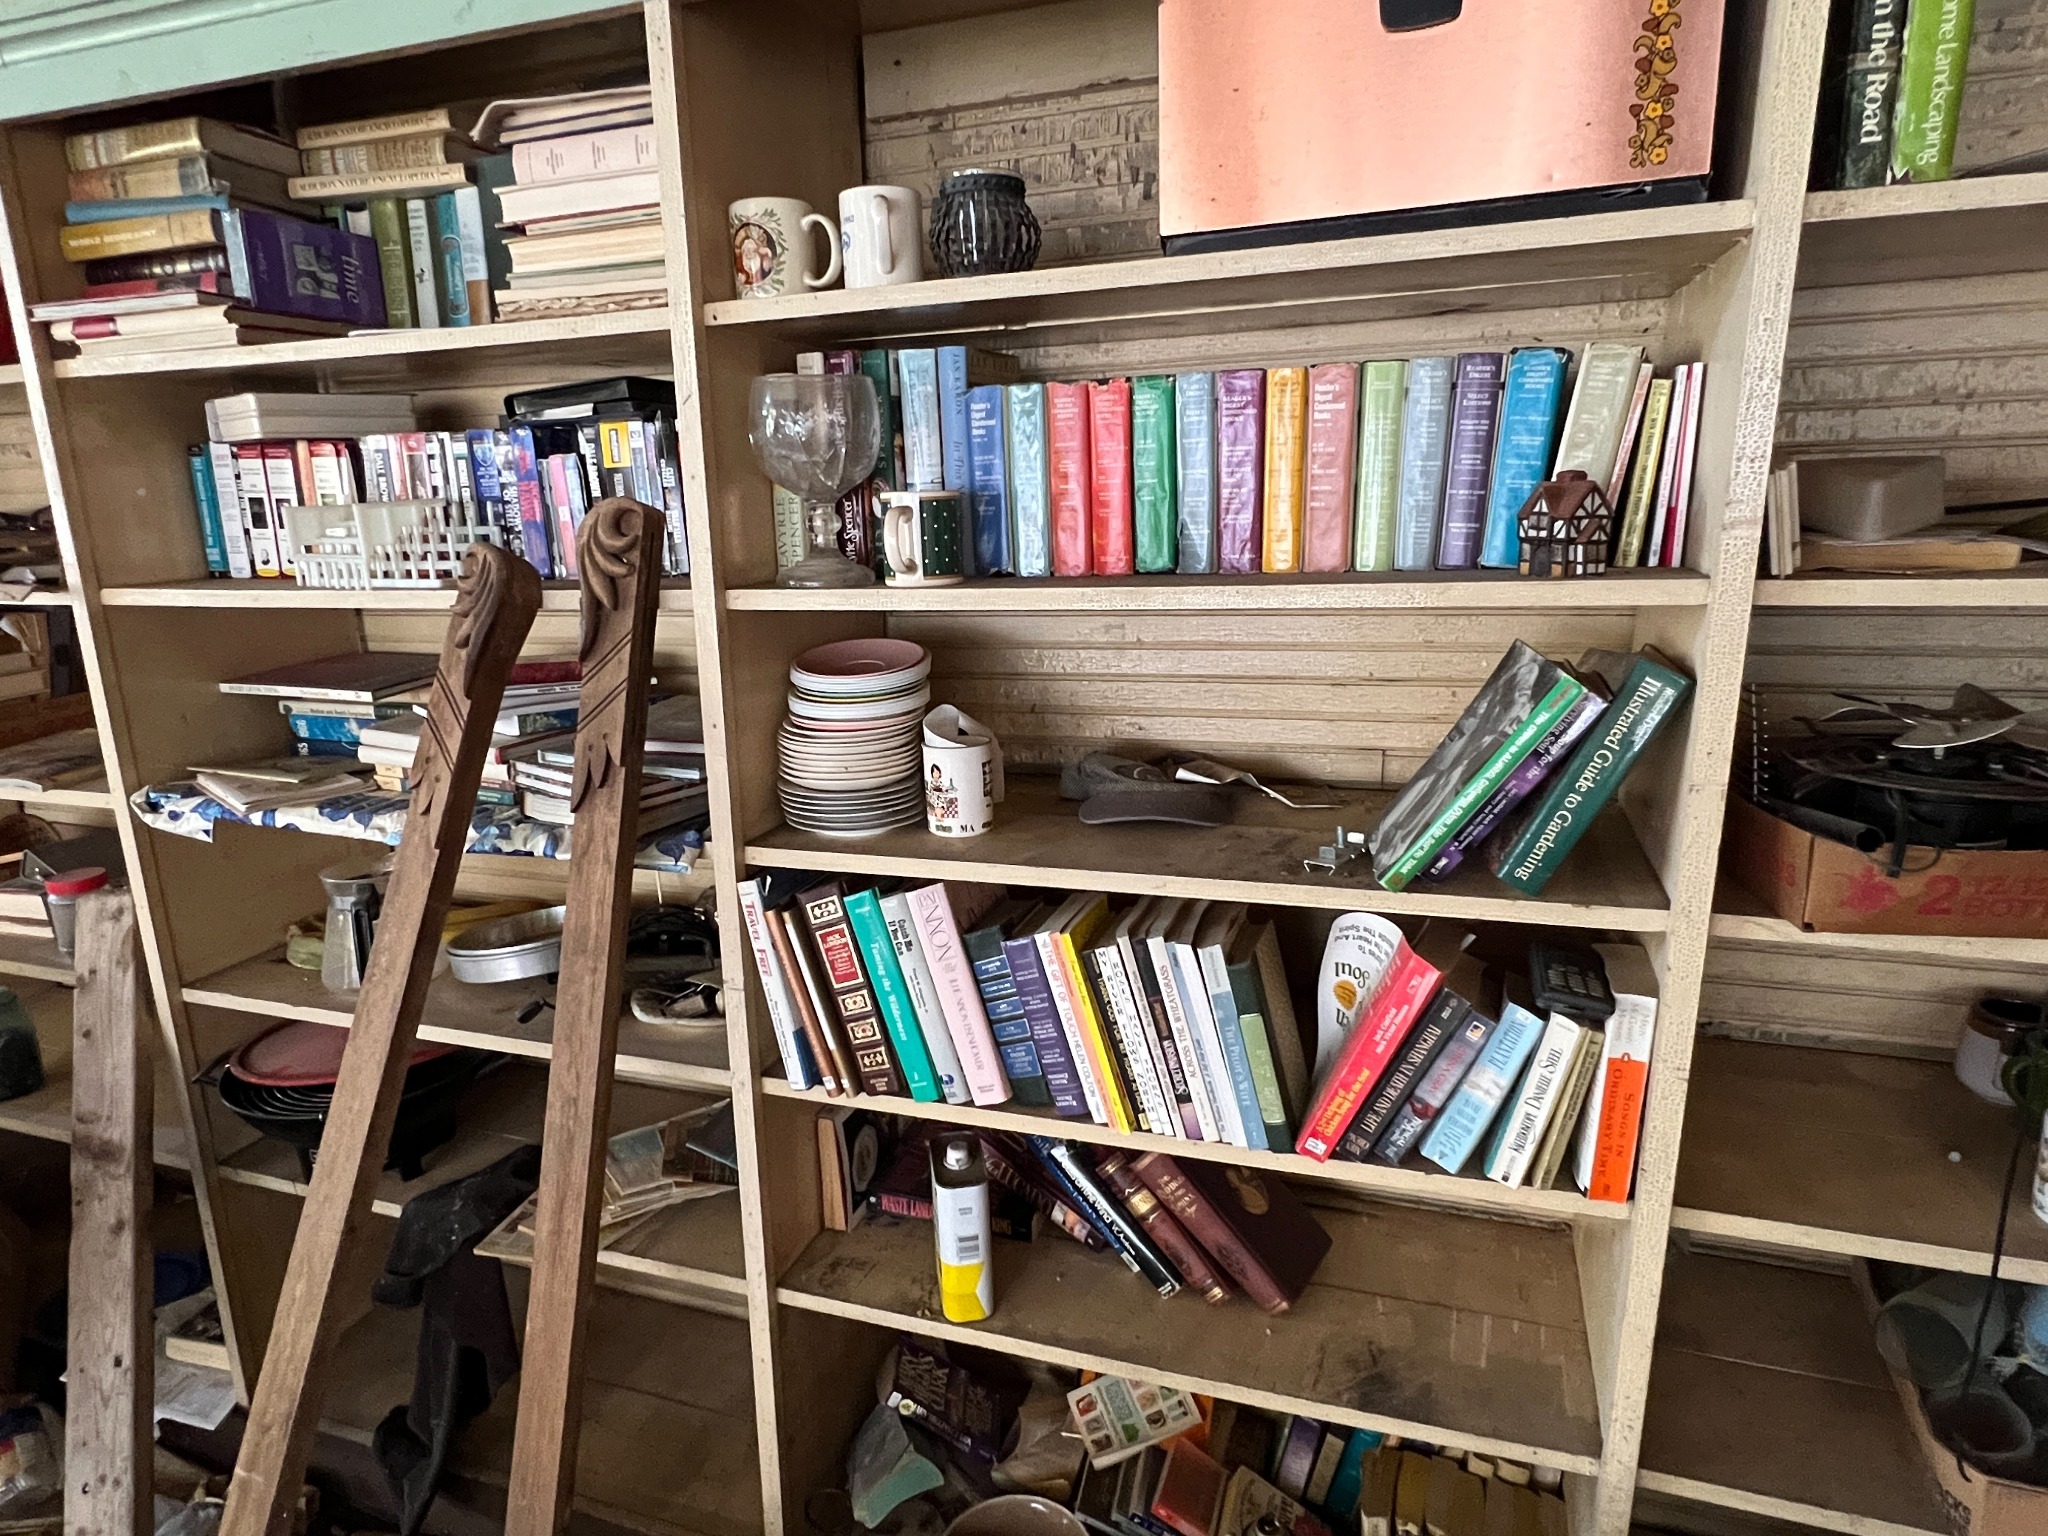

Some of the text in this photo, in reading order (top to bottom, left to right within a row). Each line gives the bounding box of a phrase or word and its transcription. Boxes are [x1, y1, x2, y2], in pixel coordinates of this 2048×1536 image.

[1860, 21, 1895, 144] the Road
[1917, 43, 1959, 165] Landscaping
[339, 176, 370, 189] NATURE
[372, 171, 437, 187] ENCYCLOPEDIA
[1314, 383, 1340, 391] Reader's
[1314, 393, 1333, 401] Digest
[971, 428, 986, 436] Books
[1313, 411, 1331, 419] Books
[374, 453, 386, 474] DALE
[505, 503, 516, 528] STEEL
[511, 486, 523, 532] SHADOWS
[844, 501, 861, 542] Spencer
[779, 497, 788, 568] LAVYRLE
[1535, 736, 1556, 754] Soul
[1538, 754, 1553, 769] for
[1514, 676, 1662, 881] Illustrated Guide to Gardening
[1525, 765, 1541, 780] the
[959, 824, 975, 833] MA
[1918, 875, 1962, 916] 2
[744, 901, 773, 977] TRAVEL FREE
[887, 920, 904, 957] If You Can
[896, 918, 913, 953] Catch Me
[925, 904, 953, 961] NIXON
[1339, 924, 1376, 937] The Spirit
[1352, 934, 1372, 947] Heart
[1358, 945, 1366, 954] To
[870, 942, 908, 1042] Taming the Wilderness
[1335, 962, 1370, 989] Soul
[1045, 946, 1097, 1099] THE GIFT OF TOUCH HELEN COLTON
[1098, 951, 1156, 1113] MY RIVER FLOWS NORTH
[1112, 961, 1165, 1108] ROSES HAVE THORNS
[1159, 964, 1198, 1079] ACROSS THE WHEATGRASS
[1371, 1027, 1384, 1042] Jack
[1373, 1002, 1410, 1054] Mark Victor Hansen
[1097, 977, 1146, 1112] THANK GOD FOR MY HEART ATTACK
[1487, 1020, 1527, 1072] PLANTATION
[1224, 1025, 1251, 1106] THE PILOT'S WIFE
[1359, 1023, 1442, 1133] LIFE AND DEATH IN SHANGHAI
[1426, 1071, 1448, 1097] GRAY
[1322, 1112, 1342, 1137] Chicken
[1335, 1097, 1353, 1117] Soup
[1355, 1066, 1370, 1083] Soul
[1508, 1046, 1564, 1156] KALEIDOSCOPE DANIELLE STEEL
[1598, 1068, 1624, 1180] ORDINARY TIME
[1615, 1092, 1636, 1159] SONGS IN
[880, 1194, 933, 1219] WASTE LAND
[1093, 1201, 1112, 1223] Wind
